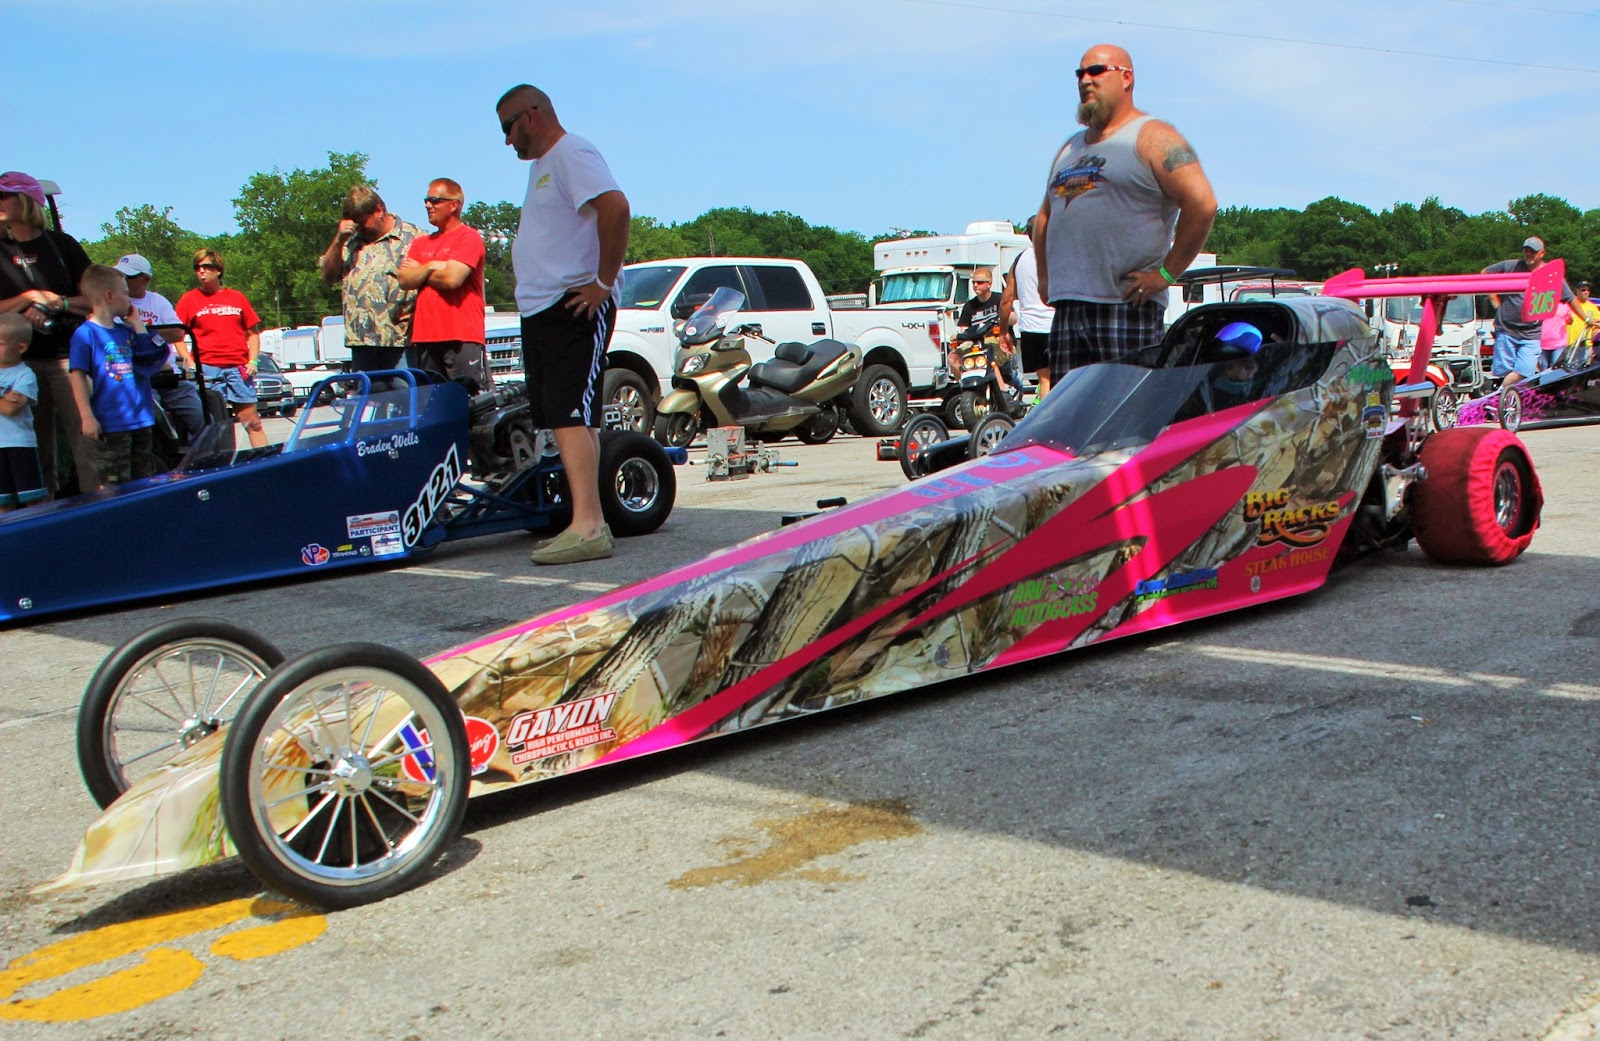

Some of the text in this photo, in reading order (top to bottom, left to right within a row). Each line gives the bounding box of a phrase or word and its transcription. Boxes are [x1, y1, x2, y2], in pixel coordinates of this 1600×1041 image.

[1528, 290, 1556, 315] 3015
[356, 432, 419, 457] Braden Wells
[402, 442, 461, 547] 3121
[1243, 488, 1290, 521] BIG
[350, 525, 399, 537] PARTICIPANT
[1259, 501, 1340, 545] RACKS
[1245, 547, 1330, 576] STEAK HOUSE
[1008, 591, 1099, 627] AUTOGLASS
[506, 692, 616, 744] GAYON
[514, 741, 568, 764] CHIROPRACTIC
[568, 740, 575, 749] &
[576, 734, 599, 747] REHAB
[527, 723, 600, 751] HIGH PERFORMANCE
